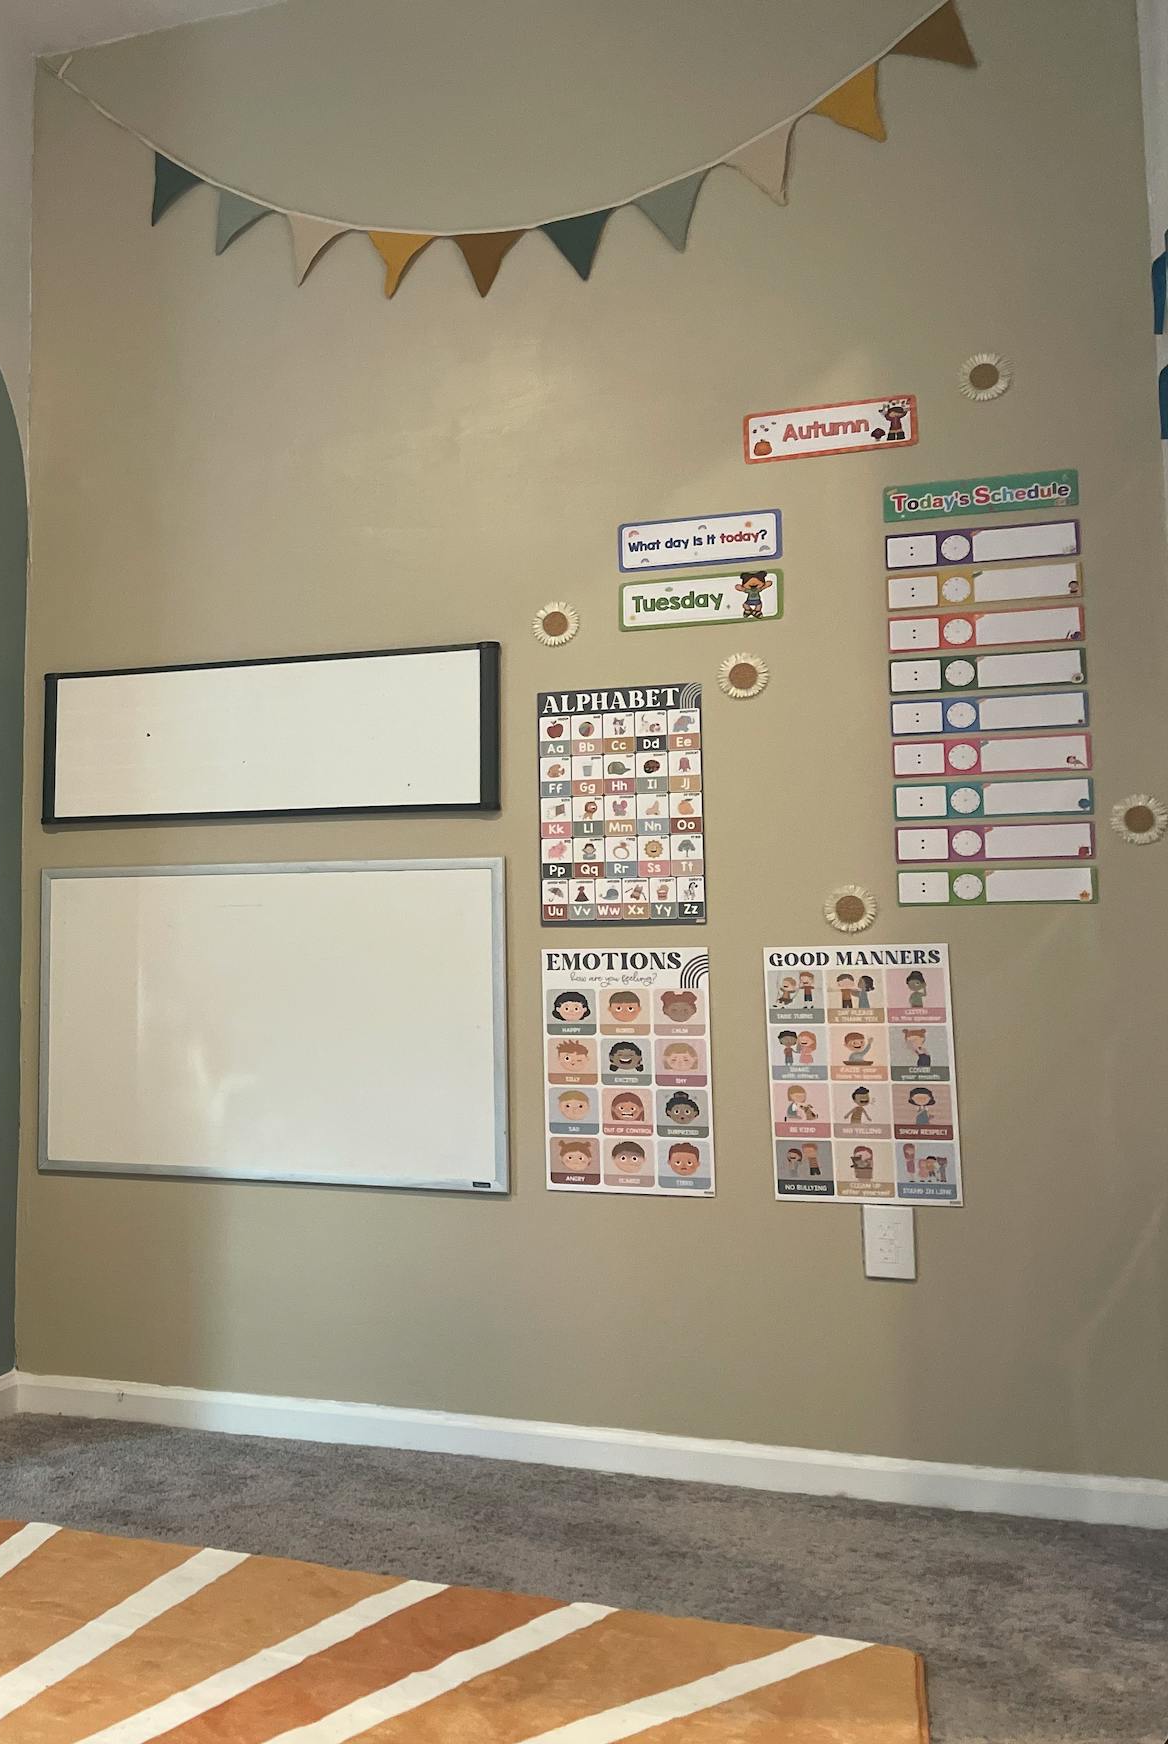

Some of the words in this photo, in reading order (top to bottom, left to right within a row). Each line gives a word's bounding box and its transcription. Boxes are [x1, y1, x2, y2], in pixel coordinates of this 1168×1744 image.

[782, 418, 870, 442] Autumn
[889, 491, 971, 514] Today's
[973, 482, 1072, 506] Schedule
[628, 538, 661, 553] What
[664, 535, 689, 550] day
[719, 529, 768, 544] today?
[631, 590, 724, 613] Tuesday
[542, 687, 680, 714] ALPHABET
[547, 744, 564, 754] Aa
[579, 742, 595, 752] Bb
[611, 740, 627, 751] Cc
[643, 738, 660, 750] Dd
[676, 736, 692, 747] Ee
[548, 783, 563, 794] Ff
[579, 782, 596, 794] Gg
[611, 780, 628, 791] Hh
[548, 824, 565, 834] Kk
[608, 822, 633, 833] Mm
[644, 821, 662, 831] Nn
[676, 820, 696, 830] Oo
[549, 865, 566, 876] Pp
[580, 863, 599, 876] Qq
[613, 863, 629, 873] Rr
[647, 862, 661, 873] Ss
[548, 906, 564, 917] Uu
[573, 906, 591, 916] Vv
[597, 905, 621, 916] Ww
[627, 904, 644, 915] Xx
[655, 904, 672, 917] Yy
[684, 903, 699, 915] Zz
[546, 952, 682, 971] EMOTIONS
[769, 951, 830, 967] GOOD
[835, 949, 941, 966] MANNERS
